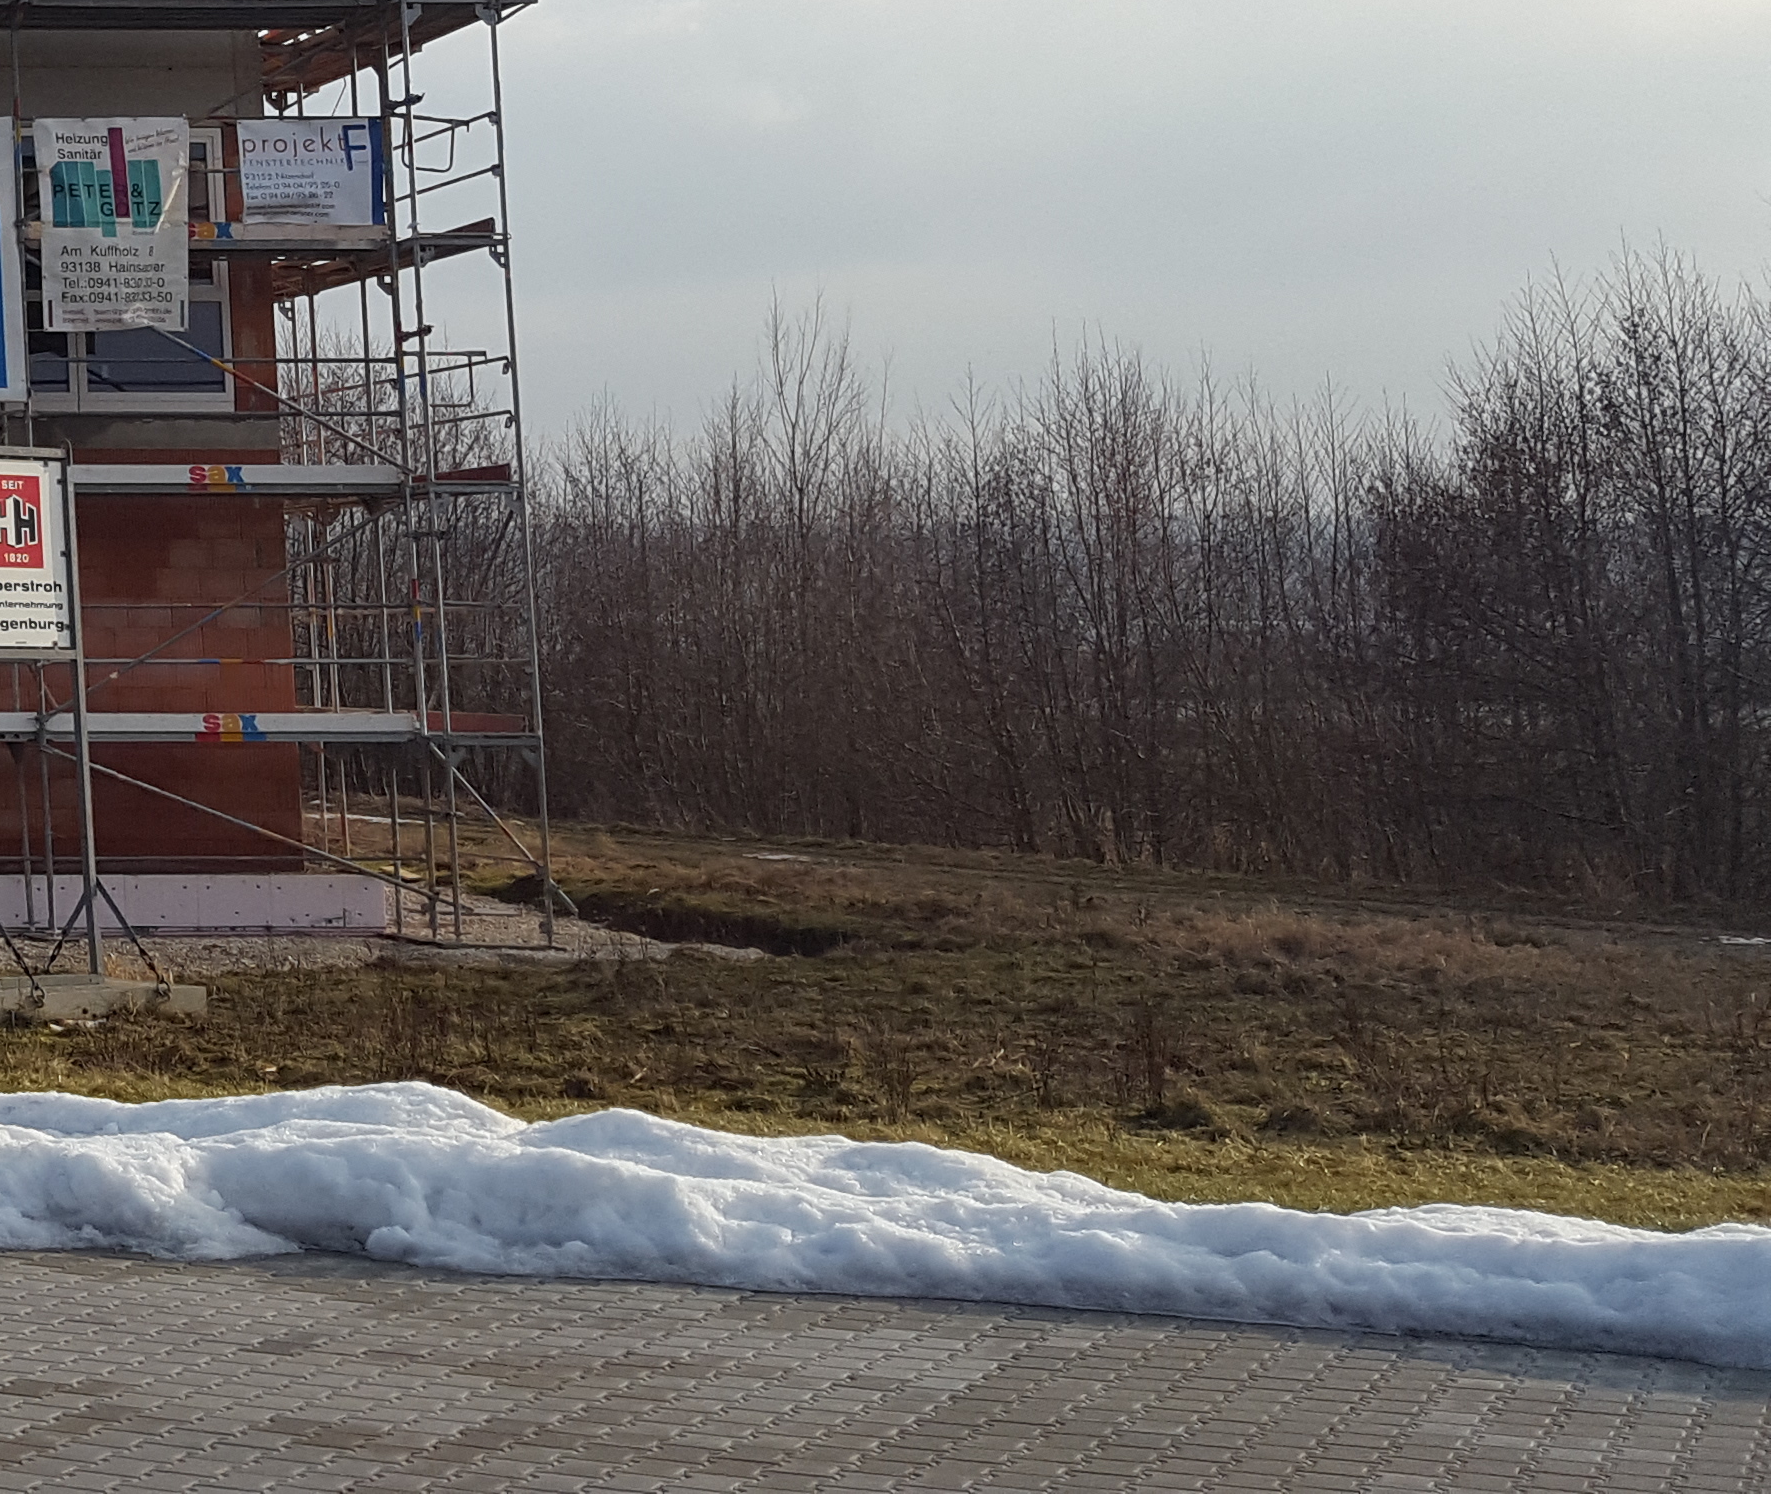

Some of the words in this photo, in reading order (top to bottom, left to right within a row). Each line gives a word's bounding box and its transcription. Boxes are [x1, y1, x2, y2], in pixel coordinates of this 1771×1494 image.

[55, 133, 109, 147] Heizung
[57, 149, 102, 160] Sanitär
[60, 246, 82, 256] Am
[60, 262, 101, 273] 93138
[189, 465, 245, 483] sax
[1, 480, 24, 489] SEIT
[202, 714, 259, 732] sax
